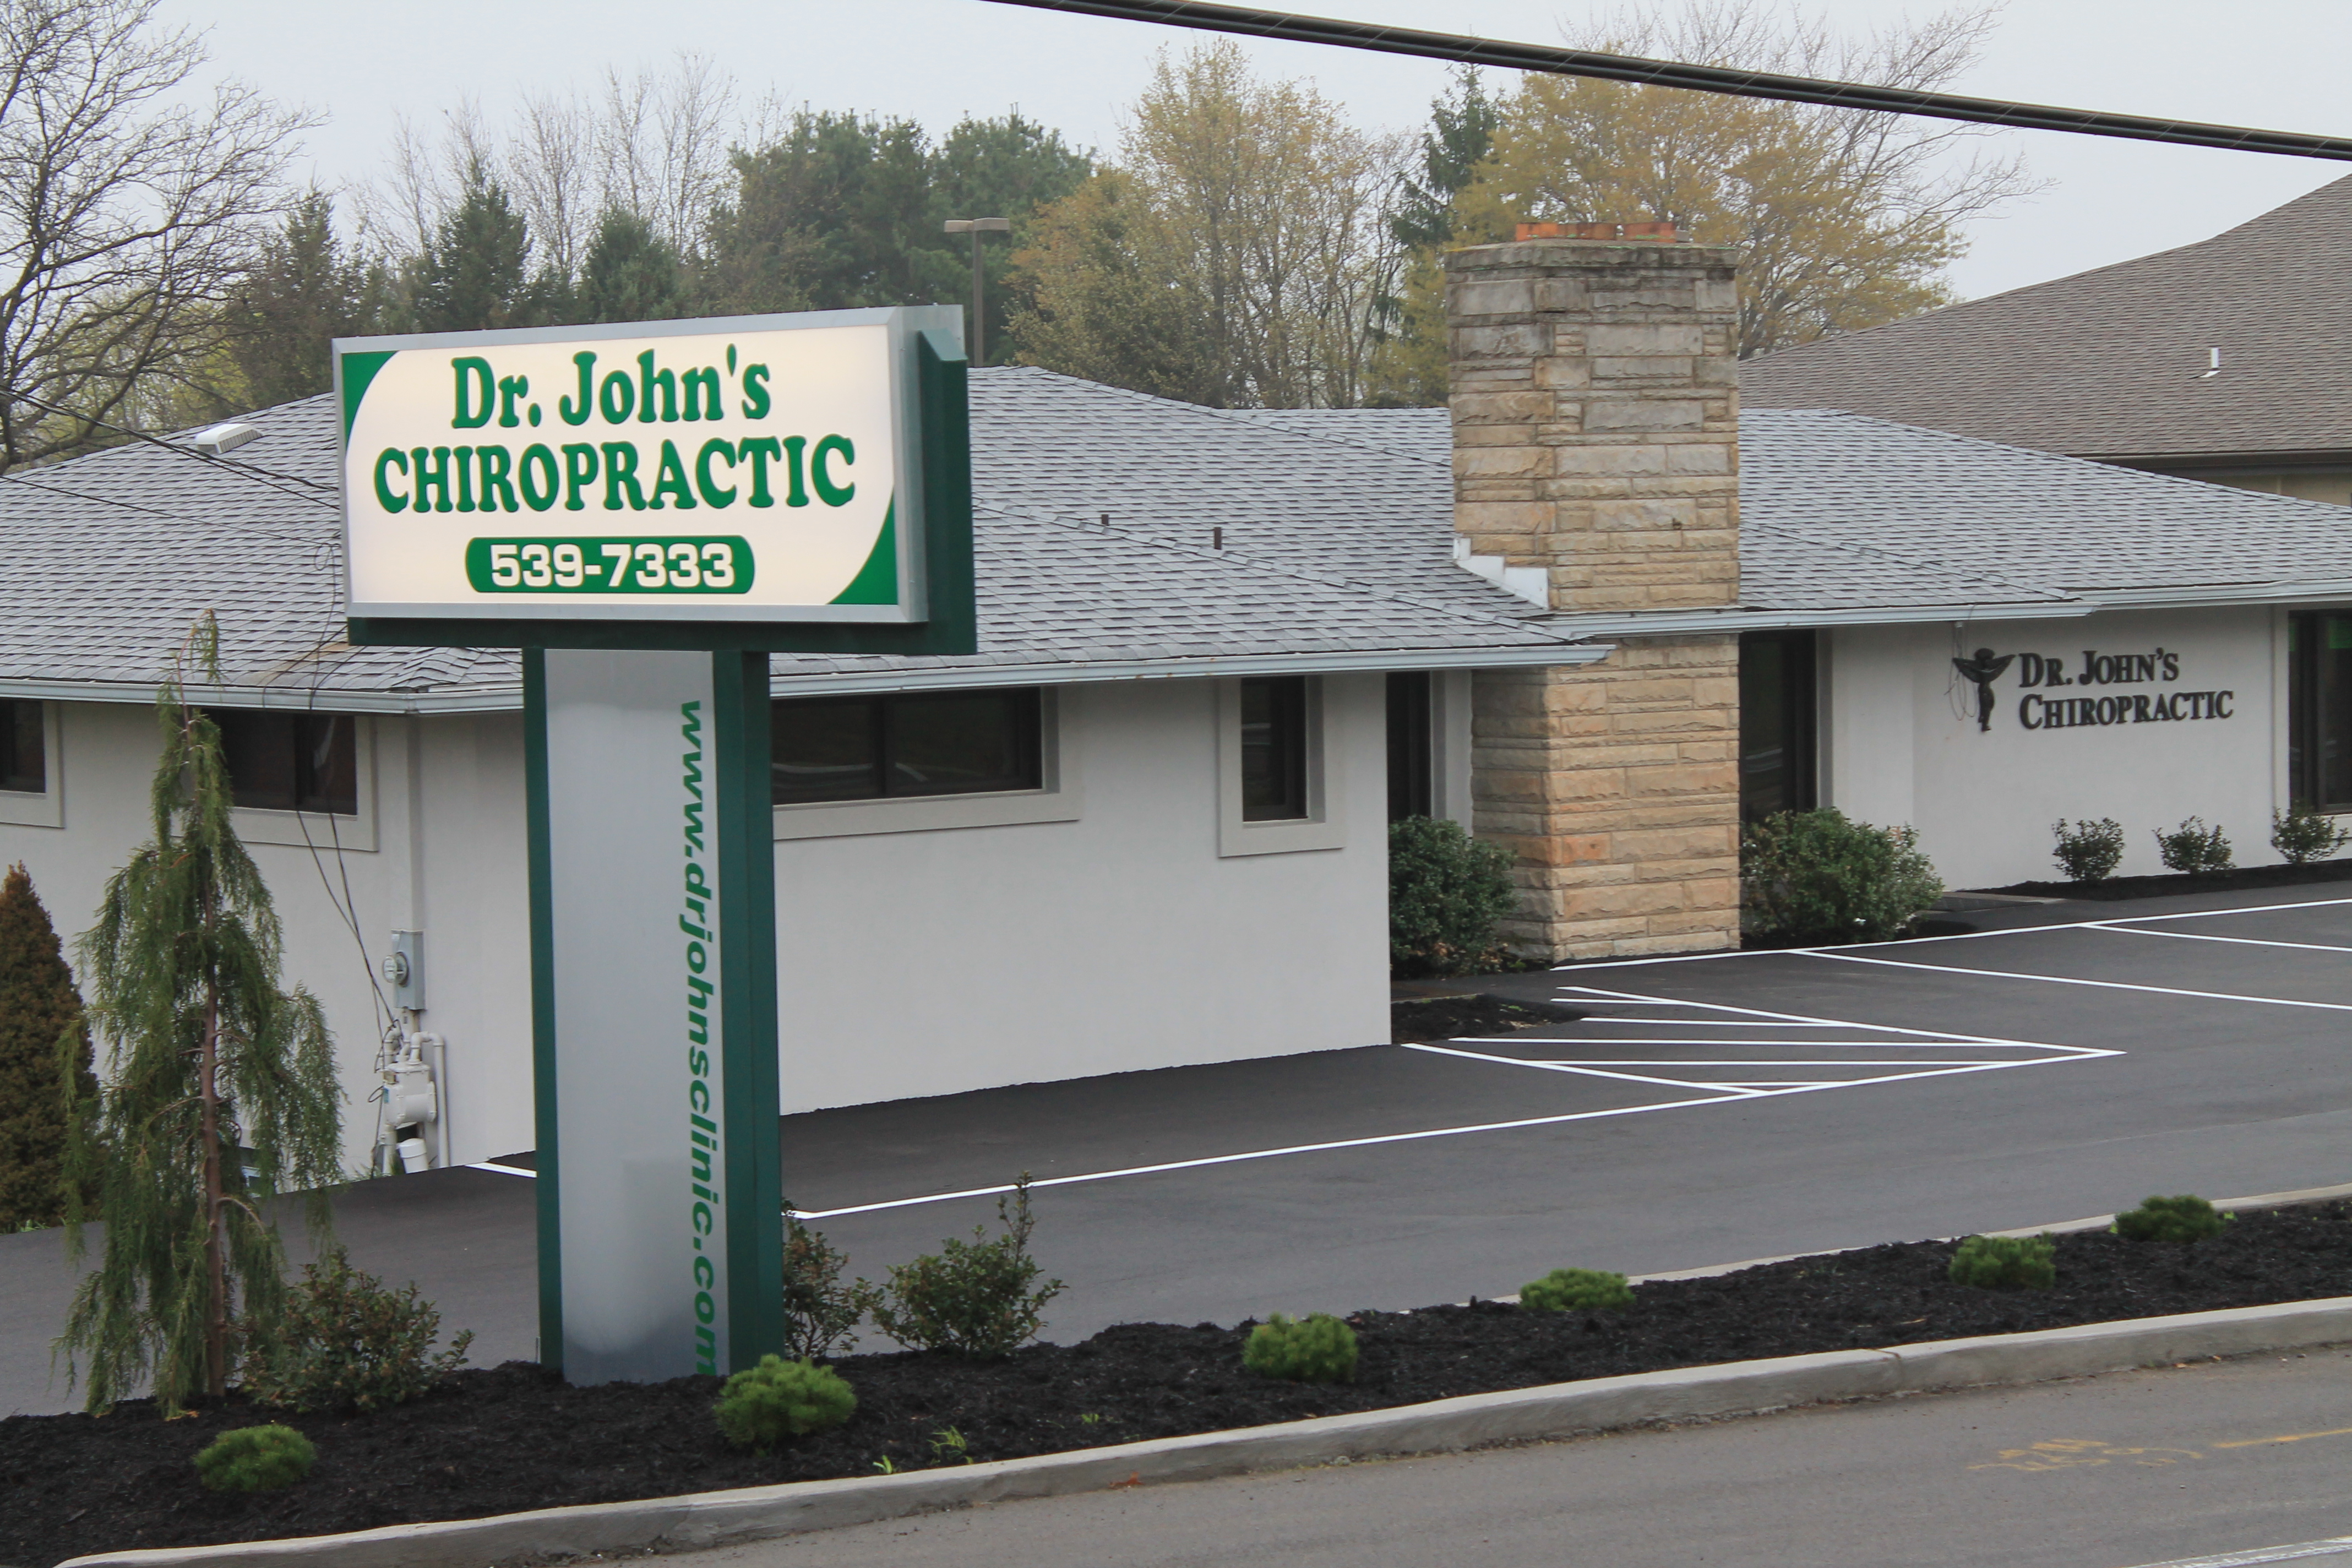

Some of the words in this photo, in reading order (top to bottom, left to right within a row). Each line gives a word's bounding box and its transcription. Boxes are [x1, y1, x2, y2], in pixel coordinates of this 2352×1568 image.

[453, 357, 542, 429] Dr.
[559, 344, 771, 425] John's
[374, 434, 856, 513] CHIROPRACTIC
[491, 543, 735, 587] 539-7333
[2018, 652, 2073, 688] DR.
[2078, 647, 2179, 684] JOHN'S
[2019, 690, 2233, 730] CHIROPRACTIC
[679, 700, 717, 1375] www.drjohnsclinic.com
